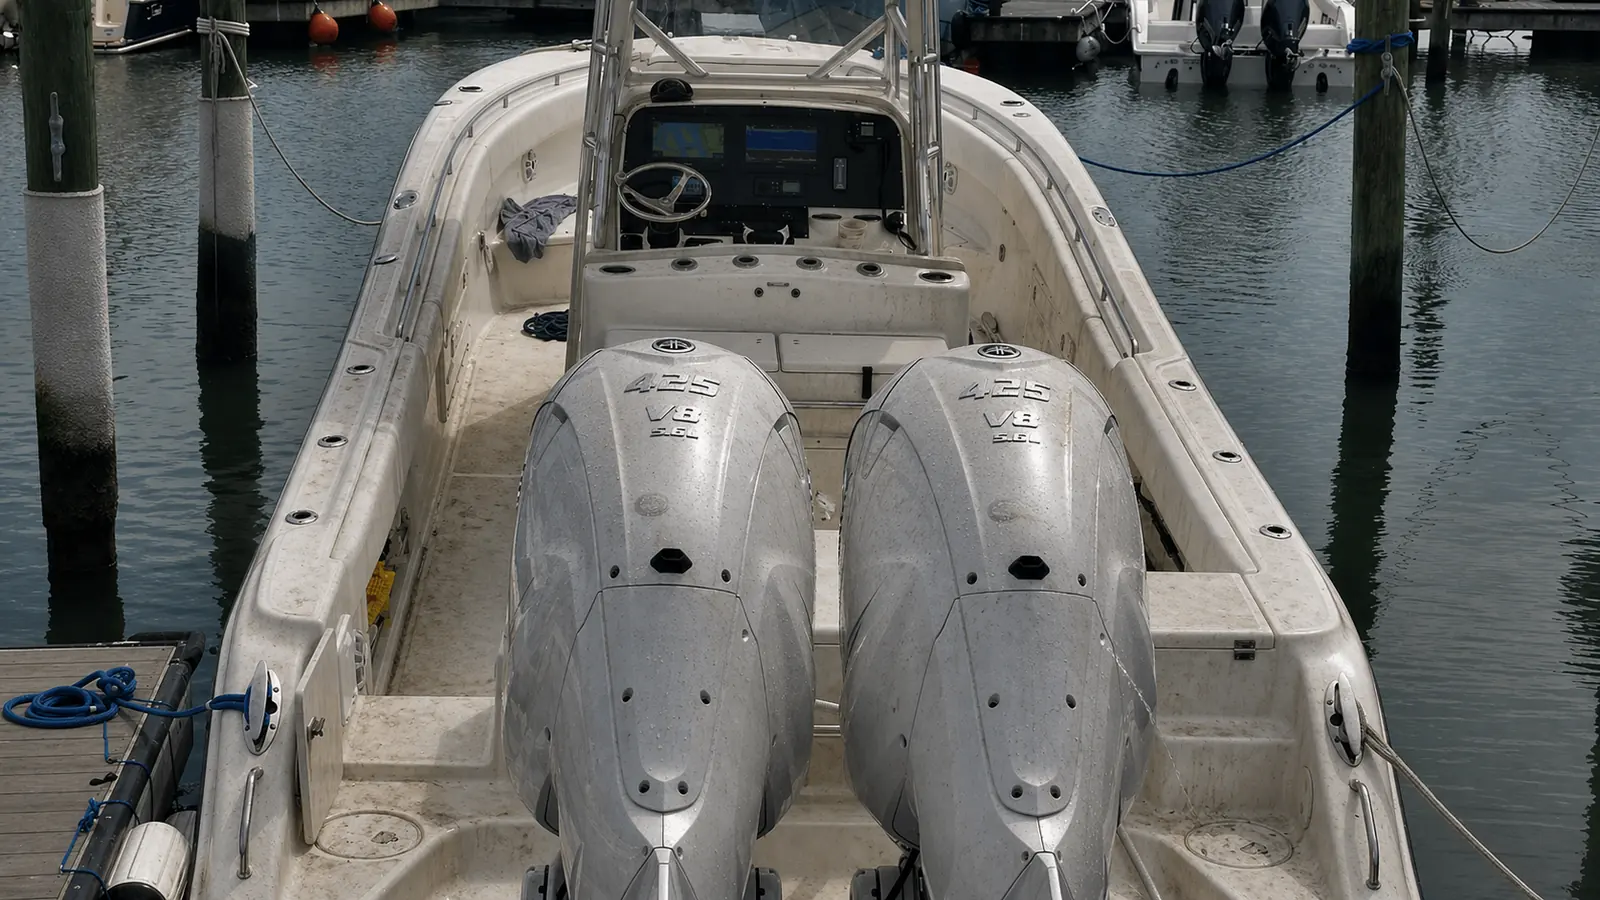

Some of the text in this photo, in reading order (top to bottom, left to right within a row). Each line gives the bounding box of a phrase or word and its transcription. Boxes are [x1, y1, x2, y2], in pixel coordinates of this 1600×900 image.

[624, 373, 720, 397] 425
[959, 379, 1051, 402] 425
[645, 405, 701, 424] V8
[983, 410, 1040, 428] V8
